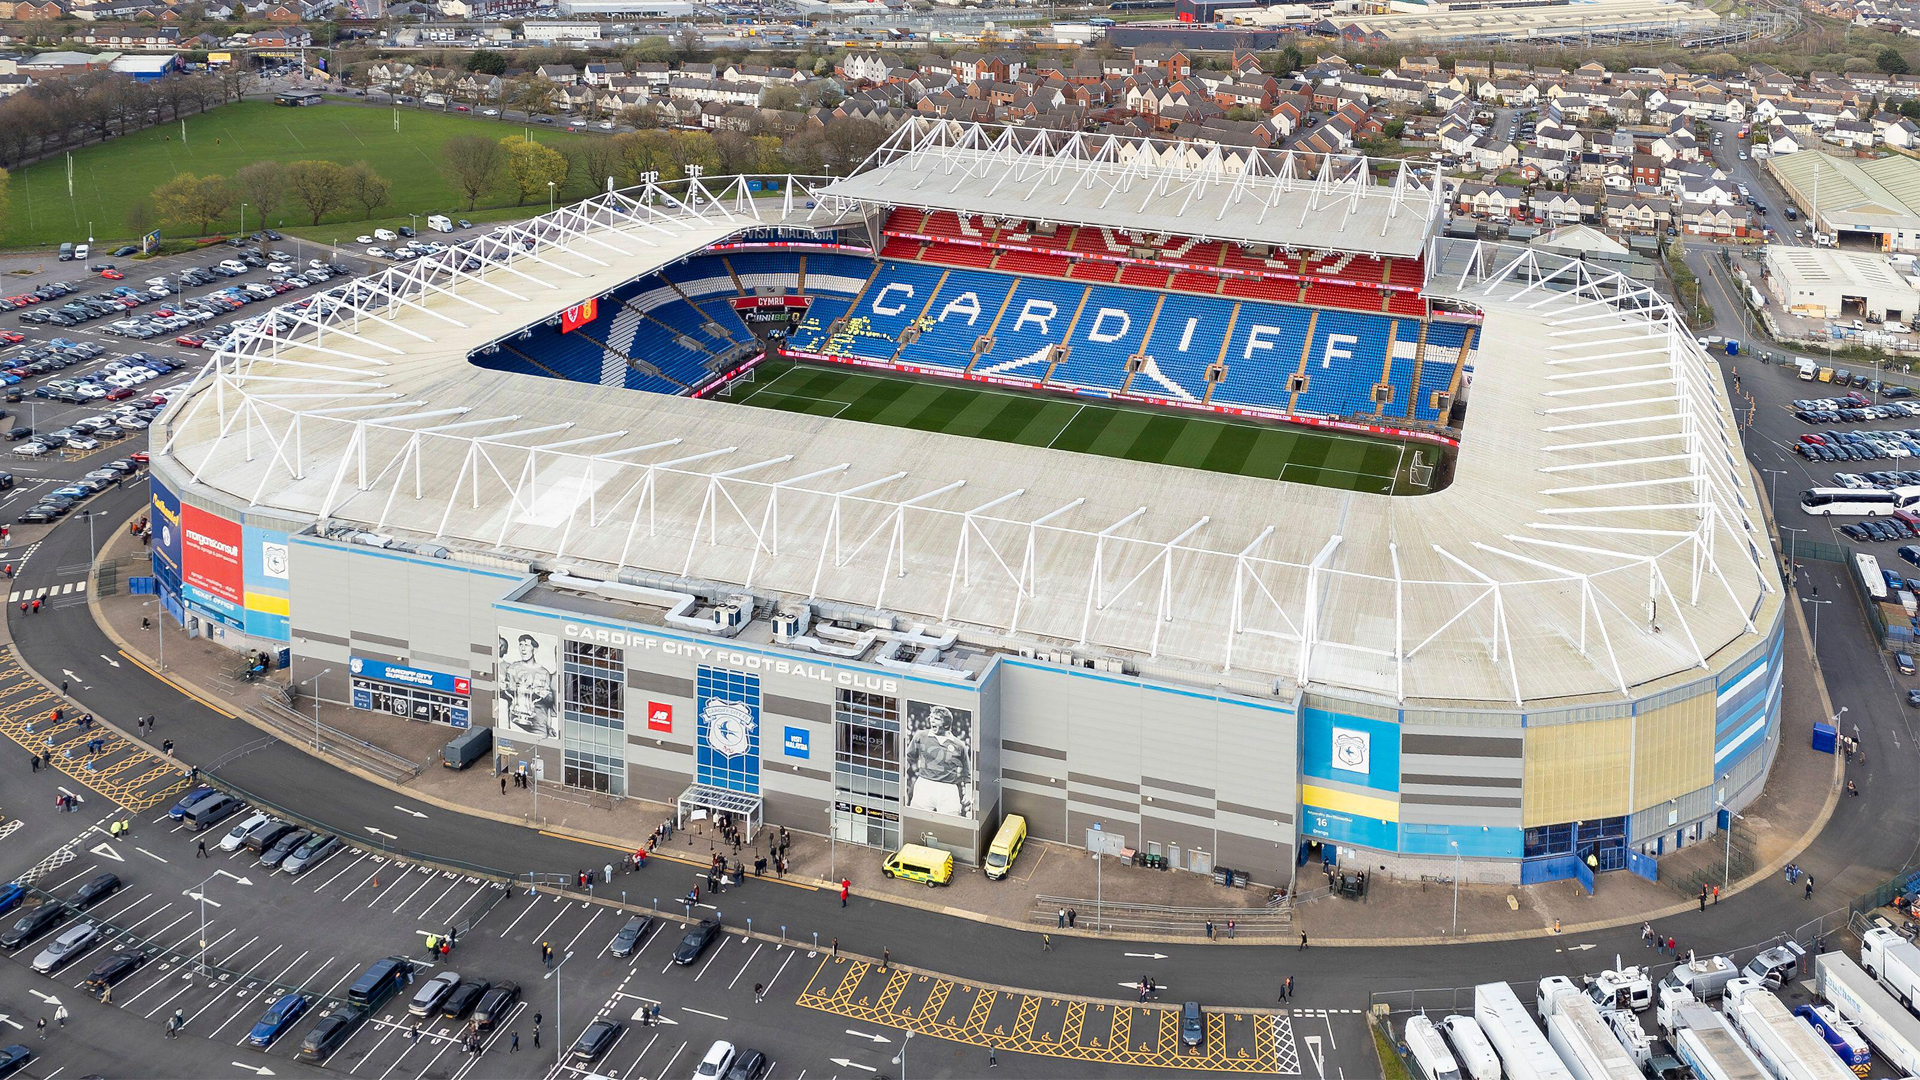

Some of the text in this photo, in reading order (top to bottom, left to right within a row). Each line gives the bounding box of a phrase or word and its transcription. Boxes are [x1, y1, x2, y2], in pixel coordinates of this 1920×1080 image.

[758, 296, 784, 306] CYMRU
[872, 283, 1357, 369] CARDIFF
[192, 588, 212, 601] TICKET
[213, 596, 234, 611] OFFICE
[564, 623, 898, 693] CARDIFF CITY FOOTBALL CLUB
[385, 667, 433, 680] CARDIFF CITY
[385, 672, 433, 686] SUPERSTORE
[791, 736, 802, 744] VISIT
[1316, 818, 1328, 827] 16
[370, 854, 384, 864] P10
[394, 860, 406, 868] P11
[417, 866, 432, 875] P12
[442, 871, 458, 880] P13
[465, 876, 480, 885] P14
[490, 882, 505, 890] P15
[616, 908, 622, 916] 4
[742, 936, 750, 944] 8
[807, 950, 816, 958] 10
[876, 966, 887, 974] 68
[1006, 992, 1014, 1000] 71
[1095, 1004, 1105, 1012] 73
[1233, 1014, 1243, 1022] 76
[373, 1023, 386, 1031] 67
